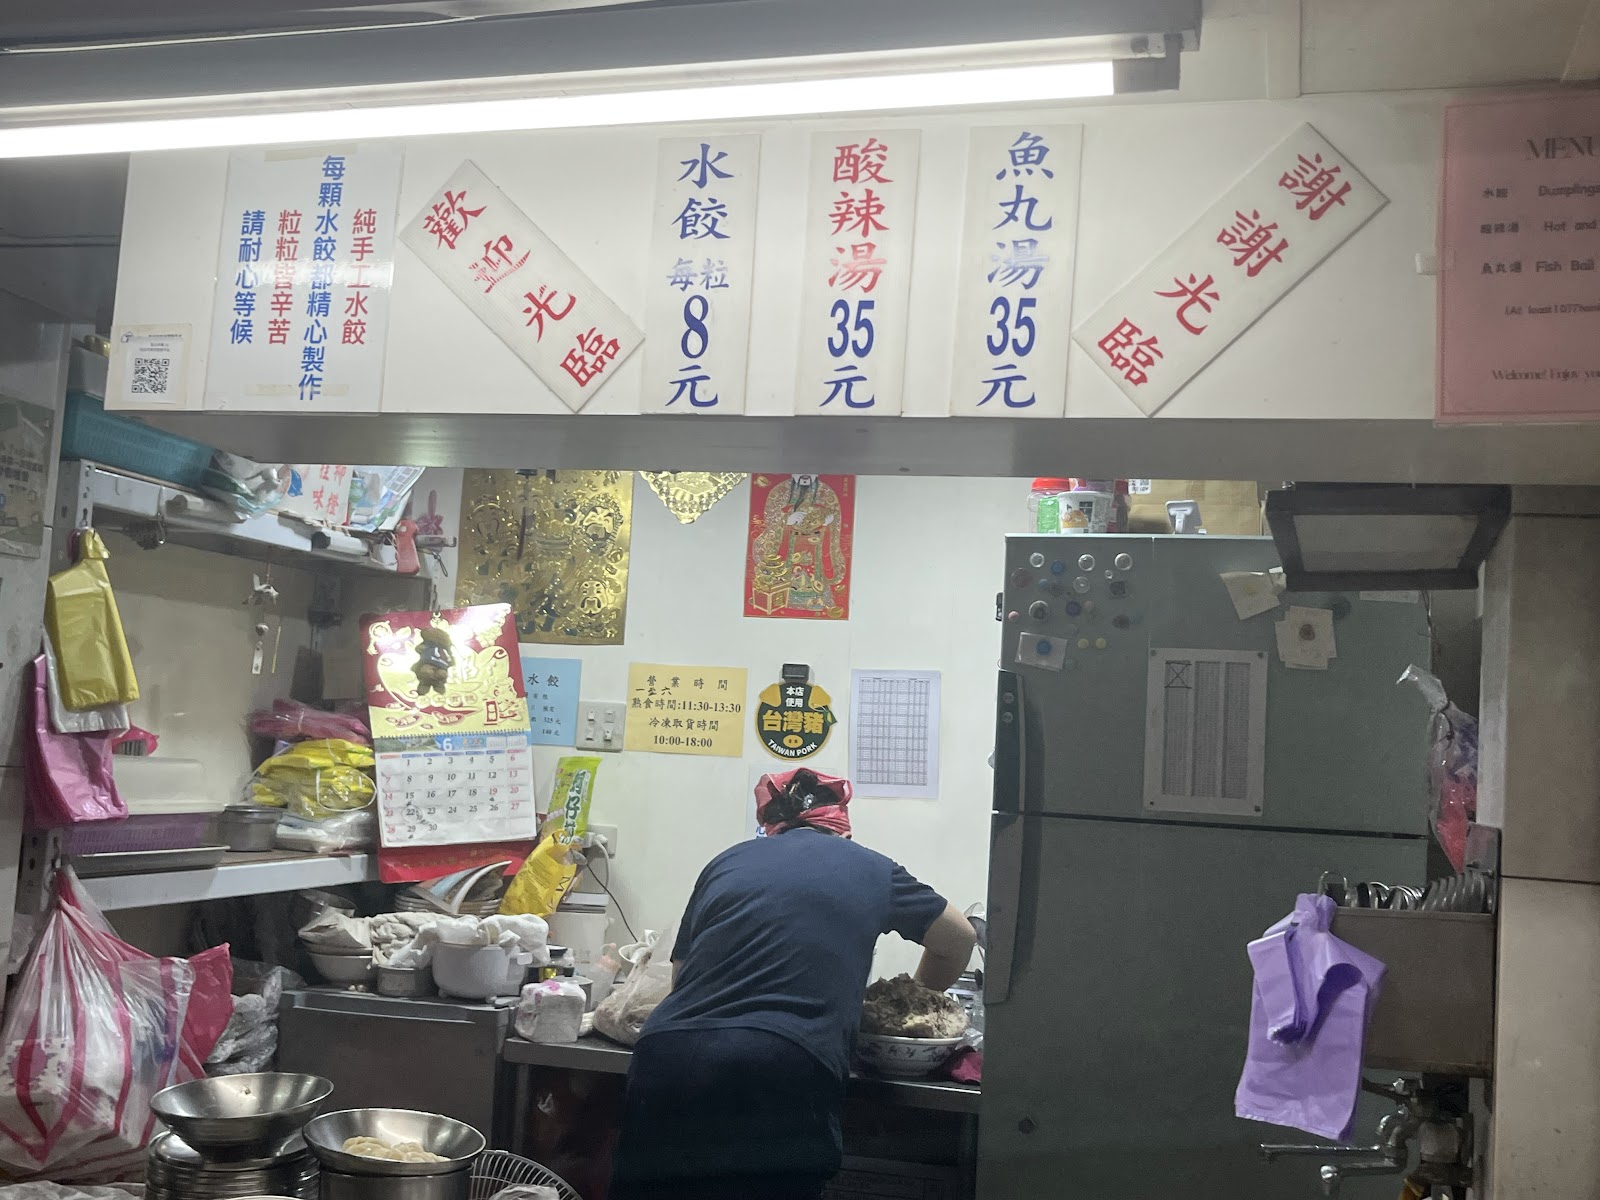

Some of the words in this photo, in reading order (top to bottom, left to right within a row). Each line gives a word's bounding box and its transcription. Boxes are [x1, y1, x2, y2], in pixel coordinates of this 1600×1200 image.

[1543, 221, 1566, 232] Hot
[1574, 219, 1597, 230] and
[1097, 152, 1352, 386] 謝謝光臨
[1535, 260, 1562, 272] Fish
[230, 209, 266, 345] 請耐心等候
[268, 209, 302, 345] 粒粒皆辛苦
[299, 155, 346, 400] 每顆水餃都精心製作
[342, 208, 377, 345] 純手工水餃
[422, 189, 621, 388] 歡迎光臨
[786, 686, 804, 697] 本店
[785, 697, 804, 708] 使用
[649, 716, 719, 731] 冷凍取貨時間
[762, 709, 824, 735] 台灣豬
[442, 738, 453, 751] 6
[653, 735, 713, 748] 10:00-18:00
[767, 738, 796, 757] TAIWAN
[796, 741, 818, 757] PORK
[469, 756, 474, 764] 4
[407, 775, 412, 783] 8
[447, 773, 456, 781] 10
[509, 770, 518, 778] 13
[489, 788, 498, 796] 19
[406, 808, 415, 816] 22
[427, 807, 436, 815] 23
[448, 806, 457, 814] 24
[428, 823, 437, 831] 30
